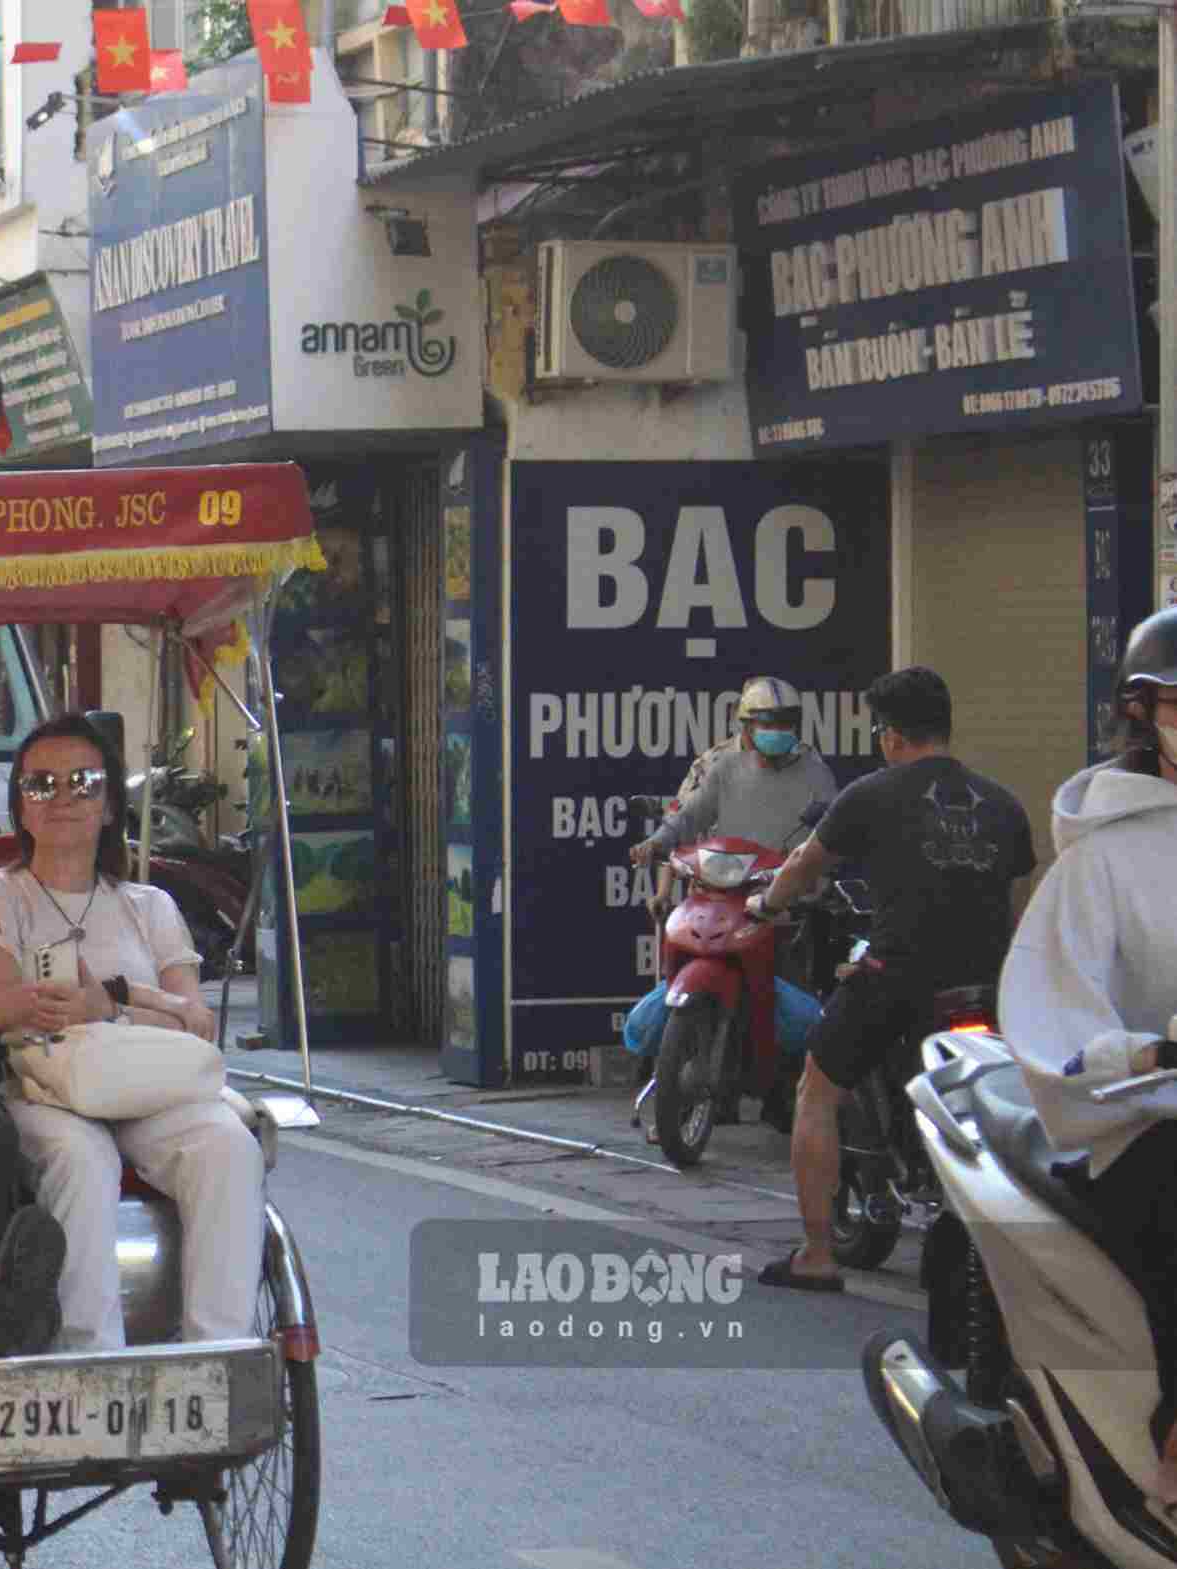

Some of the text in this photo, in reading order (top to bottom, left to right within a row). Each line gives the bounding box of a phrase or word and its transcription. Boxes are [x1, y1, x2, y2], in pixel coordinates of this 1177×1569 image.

[1030, 115, 1075, 160] ANH
[771, 186, 1070, 329] BẠC PHƯƠNG ANH
[1088, 441, 1111, 477] 33
[116, 490, 167, 529] JSC
[198, 489, 242, 526] 09
[566, 504, 837, 658] BẠC
[800, 690, 873, 756] NH
[552, 795, 628, 847] BẠC
